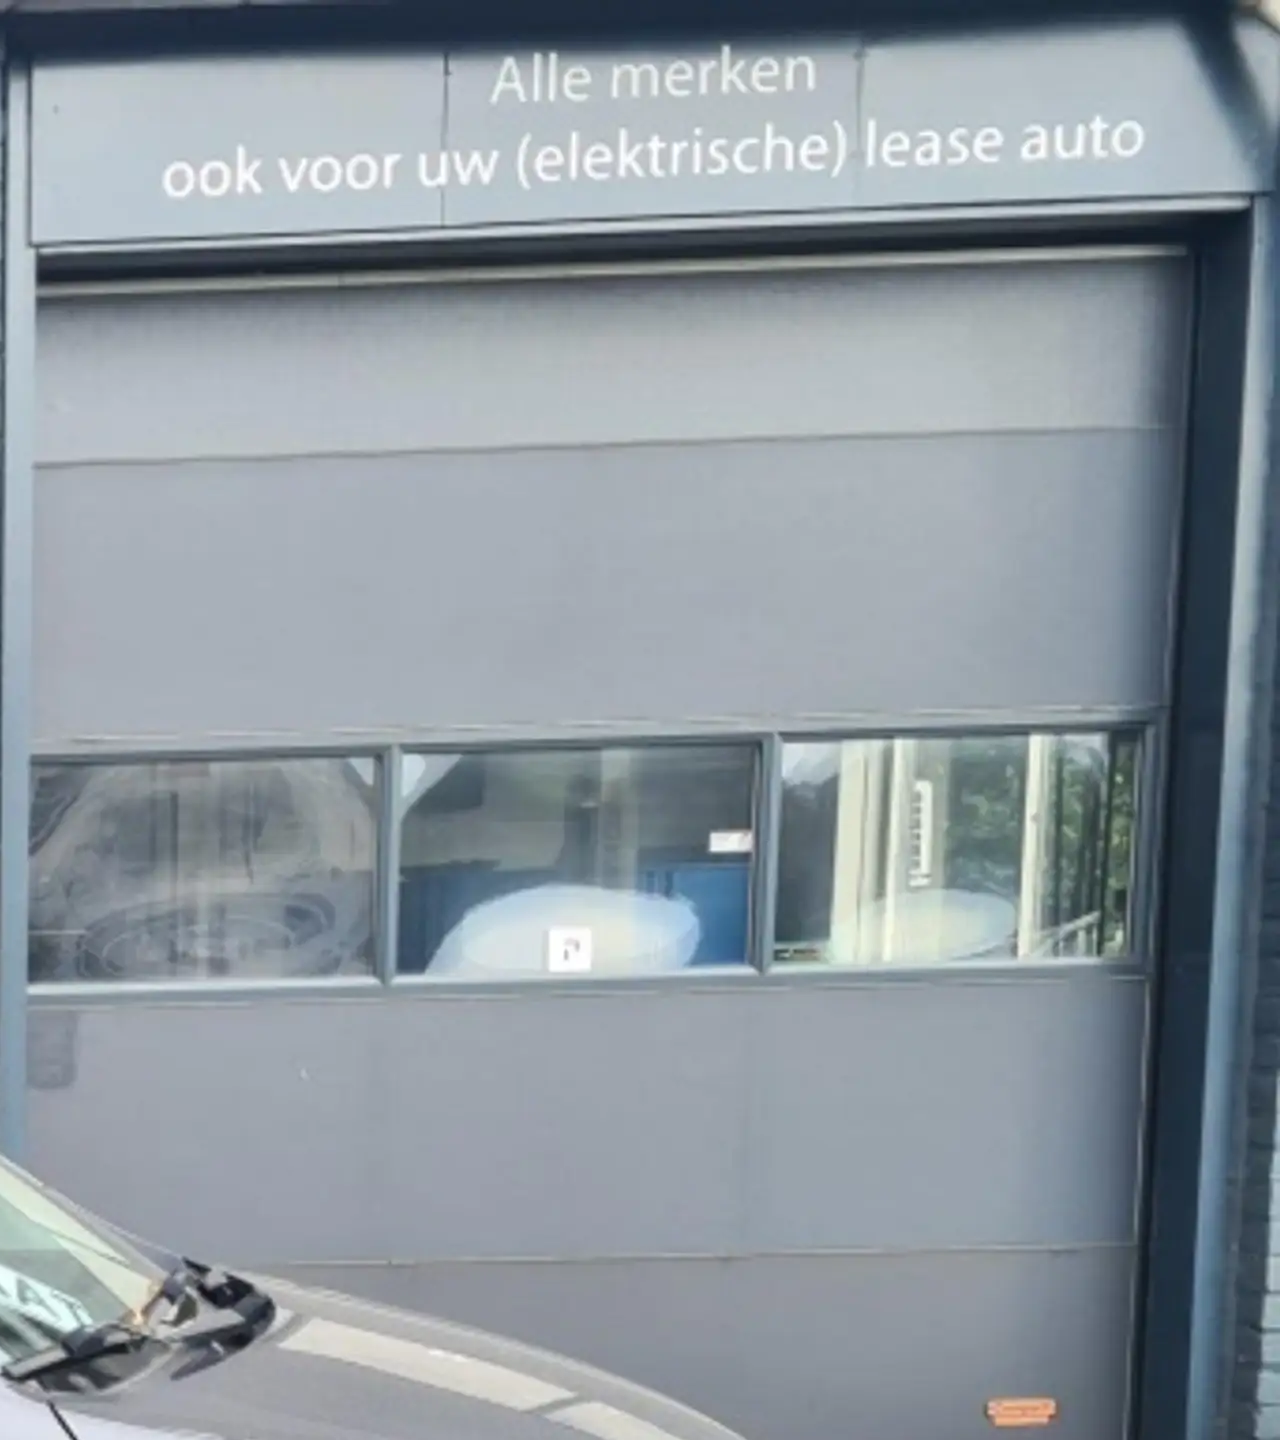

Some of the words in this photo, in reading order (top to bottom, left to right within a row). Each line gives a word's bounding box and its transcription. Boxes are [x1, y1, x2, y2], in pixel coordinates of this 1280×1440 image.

[490, 52, 592, 104] Alle
[610, 44, 817, 100] merken
[162, 144, 263, 199] ook
[278, 152, 403, 192] voor
[419, 149, 500, 188] uw
[517, 120, 848, 190] (elektrische)
[865, 118, 1005, 168] lease
[1020, 113, 1146, 161] auto
